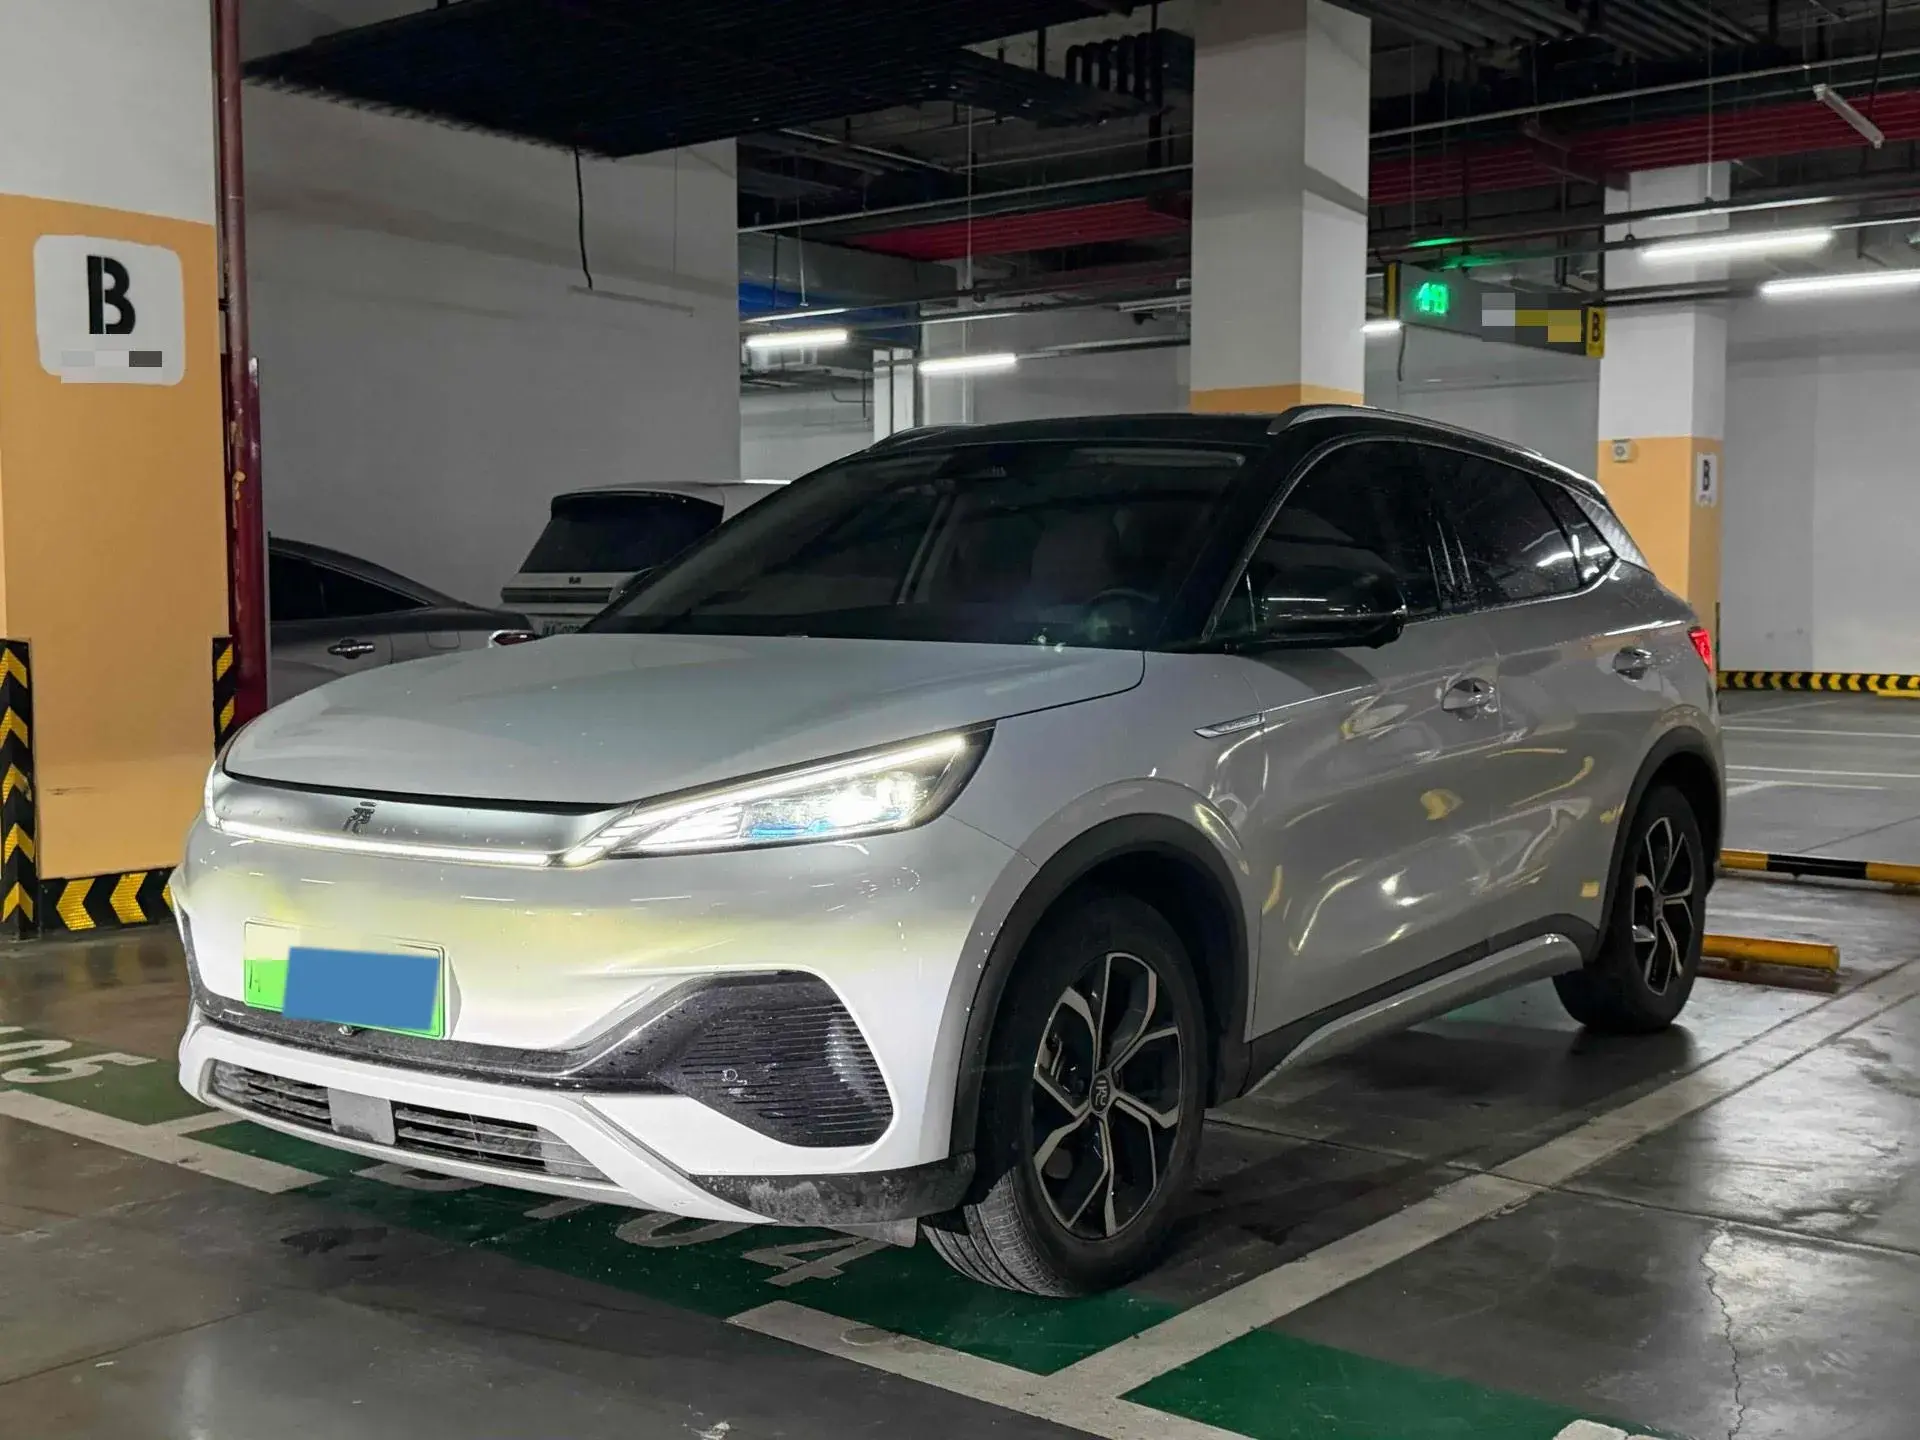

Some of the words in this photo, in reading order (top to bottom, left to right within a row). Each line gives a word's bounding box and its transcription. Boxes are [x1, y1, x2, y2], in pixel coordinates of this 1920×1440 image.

[87, 255, 136, 334] B
[1592, 312, 1601, 342] B
[1702, 459, 1711, 491] B
